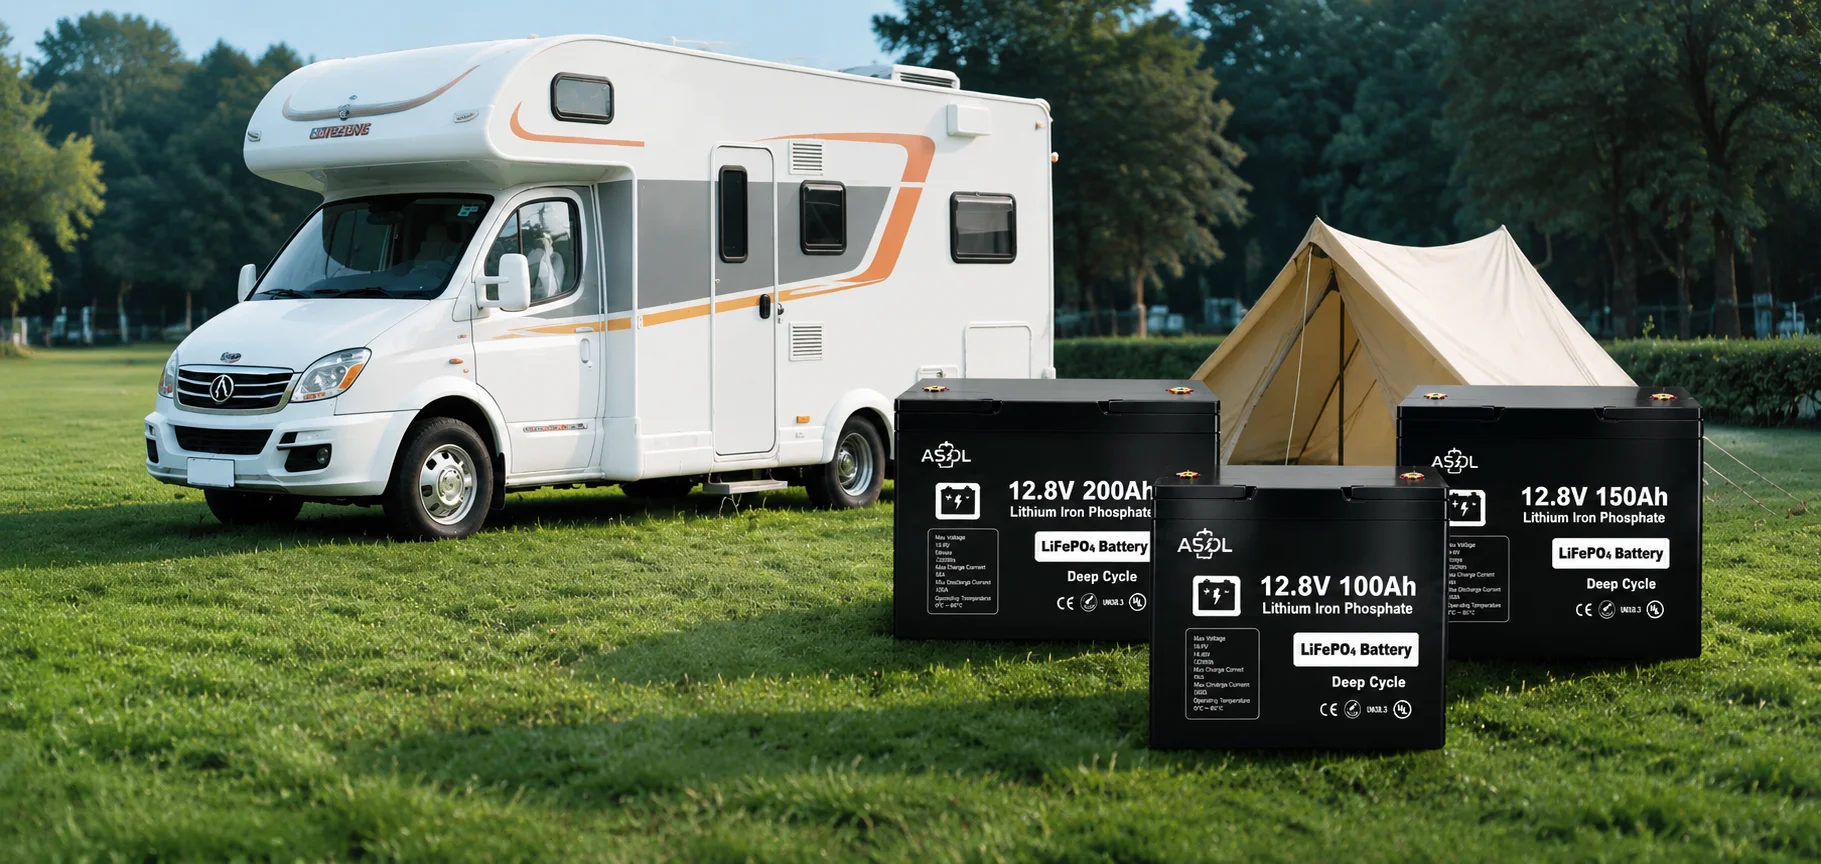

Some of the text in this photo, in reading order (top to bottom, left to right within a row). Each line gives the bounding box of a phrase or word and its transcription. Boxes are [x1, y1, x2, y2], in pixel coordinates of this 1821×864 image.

[1008, 480, 1153, 500] 12.8V 200Ah
[1521, 486, 1668, 507] 12.8V 150Ah
[1010, 505, 1057, 518] Lithium
[1060, 505, 1085, 518] Iron
[1523, 511, 1666, 527] Lithium Iron Phosphate
[1099, 540, 1148, 556] Battery
[1614, 547, 1664, 563] Battery
[1067, 569, 1138, 585] Deep Cycle
[1586, 577, 1657, 592] Deep Cycle
[1260, 575, 1417, 597] 12.8V 100Ah
[1056, 596, 1075, 611] CE
[1262, 601, 1414, 618] Lithium Iron Phosphate
[1575, 602, 1593, 617] CE
[1360, 642, 1413, 660] Battery
[1331, 675, 1407, 691] Deep Cycle
[1319, 702, 1338, 717] CE
